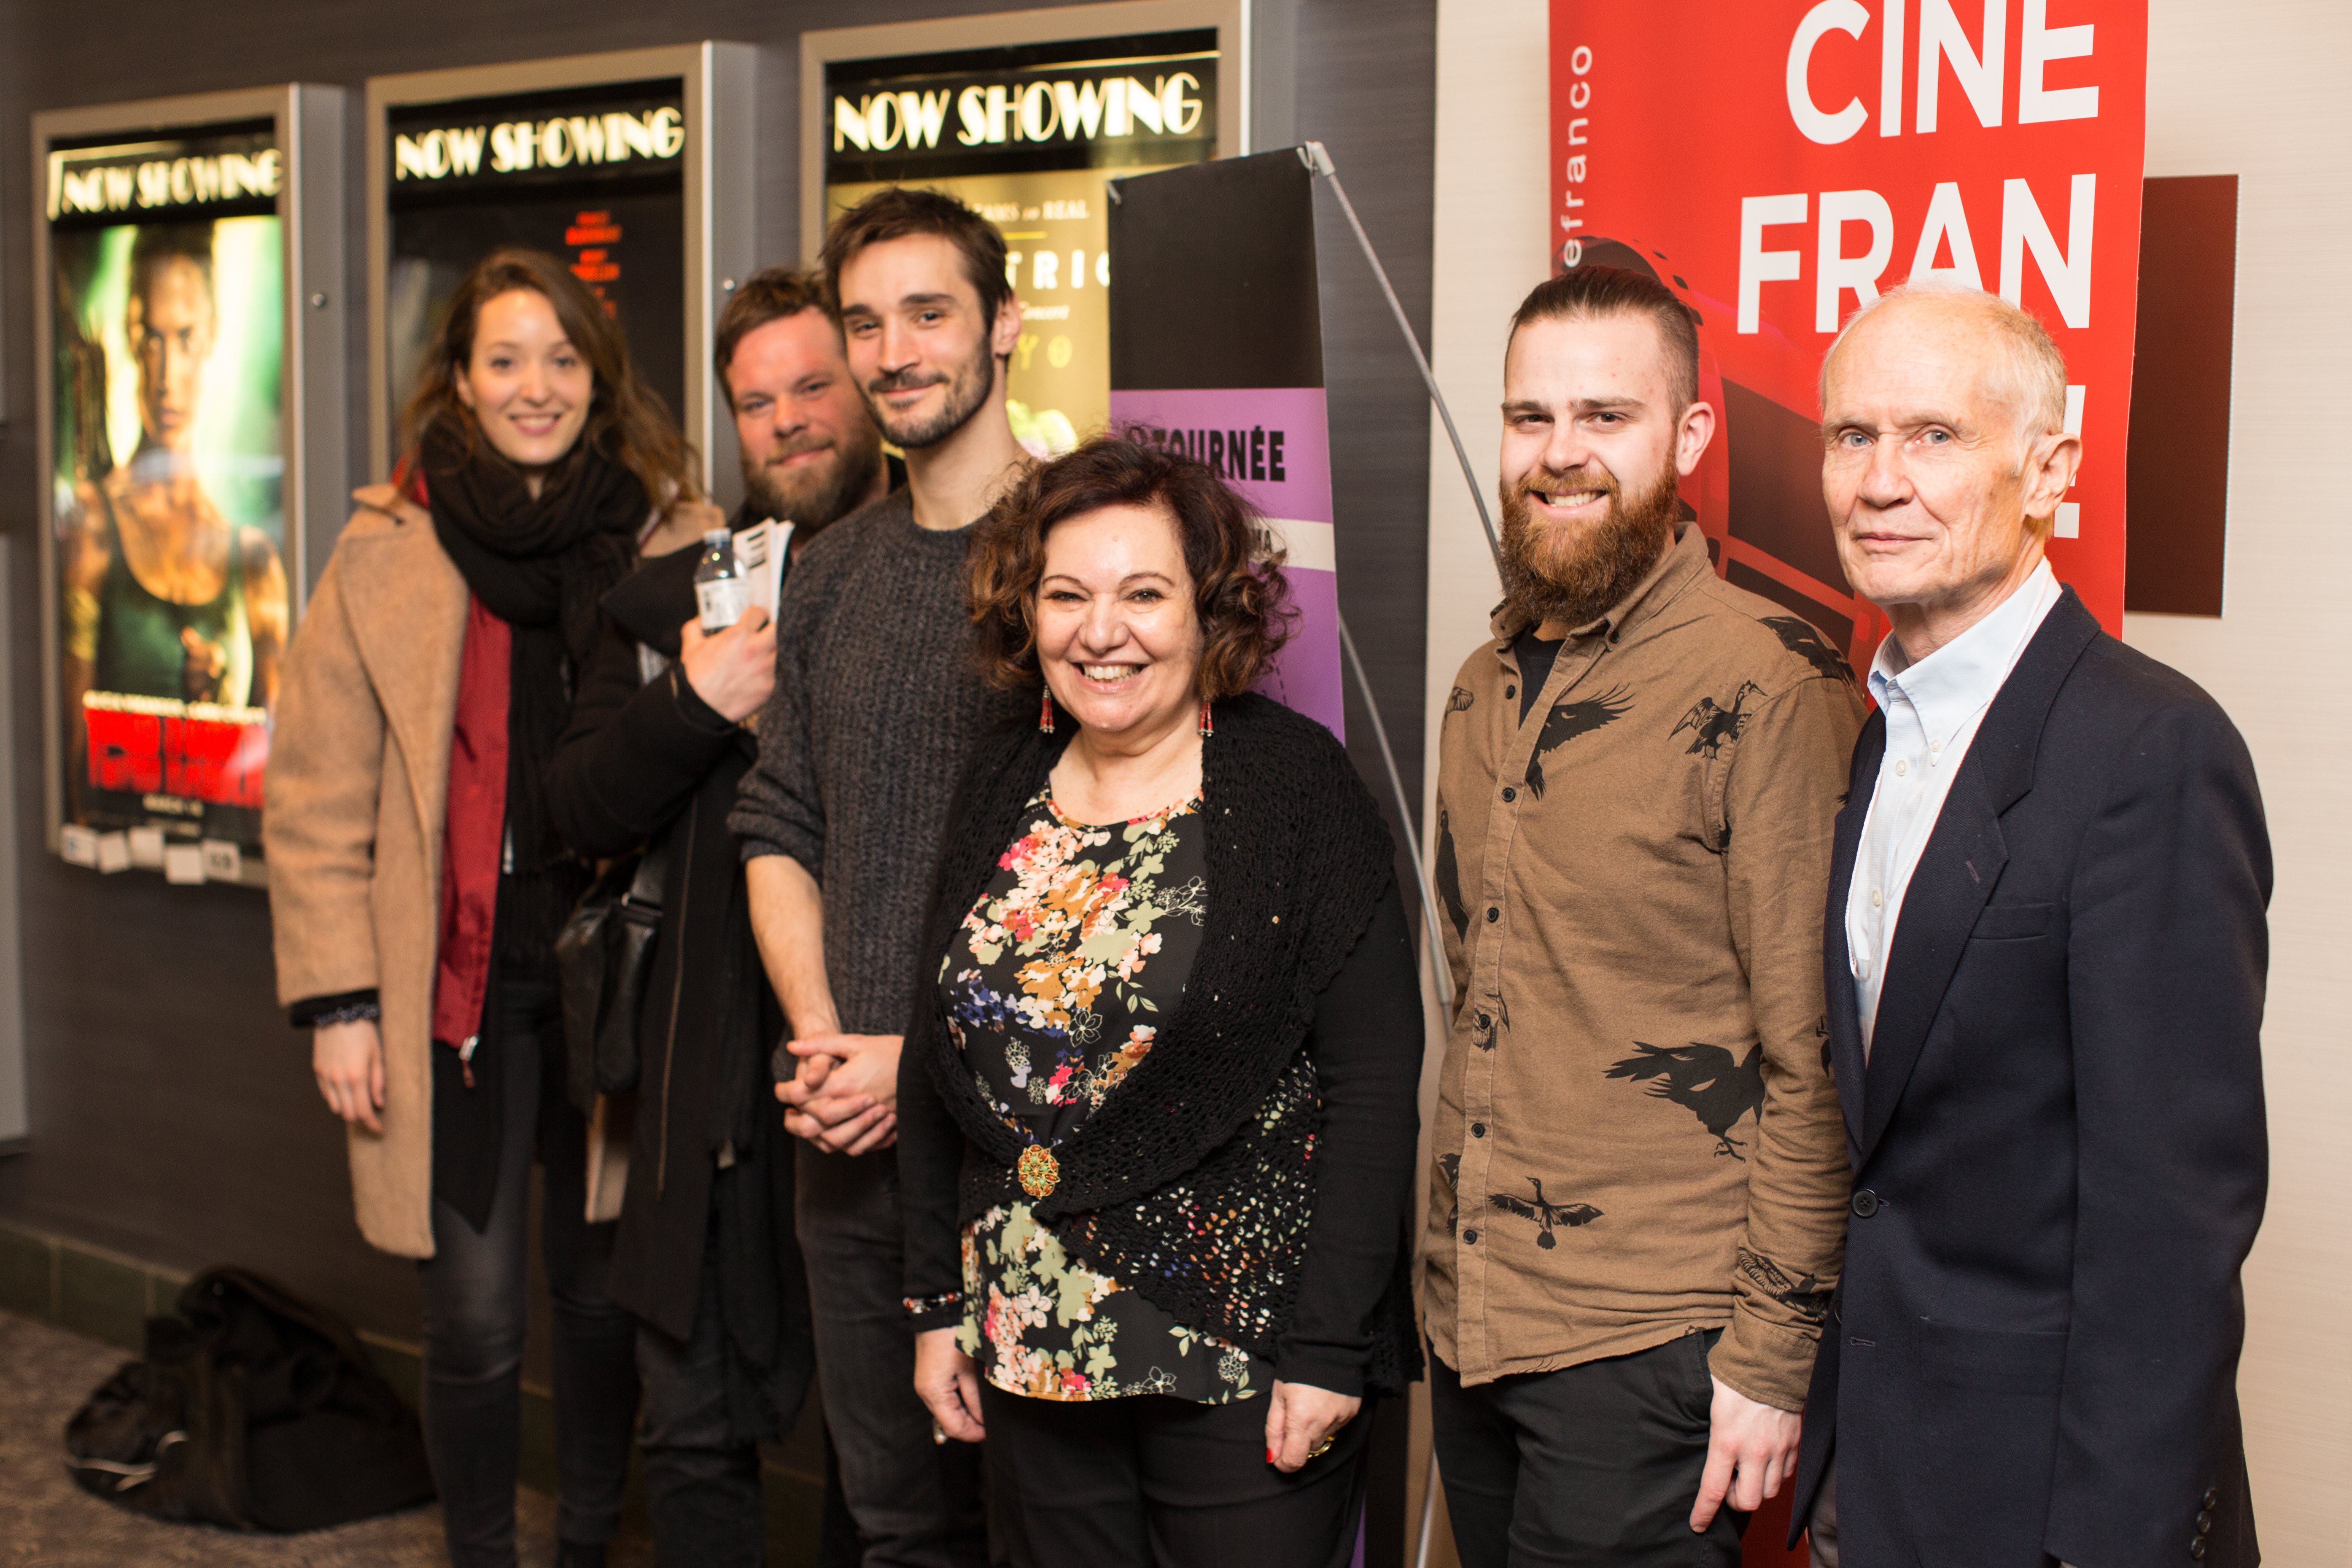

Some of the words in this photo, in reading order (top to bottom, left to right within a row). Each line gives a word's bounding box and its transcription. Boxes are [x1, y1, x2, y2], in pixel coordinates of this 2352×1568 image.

[1786, 0, 2099, 144] CINE
[395, 126, 486, 181] NOW
[490, 106, 685, 173] SHOWING
[834, 88, 951, 152] NOW
[956, 73, 1203, 146] SHOWING
[60, 166, 135, 214] NOW
[136, 148, 283, 209] SHOWING
[1737, 173, 2096, 334] FRAN
